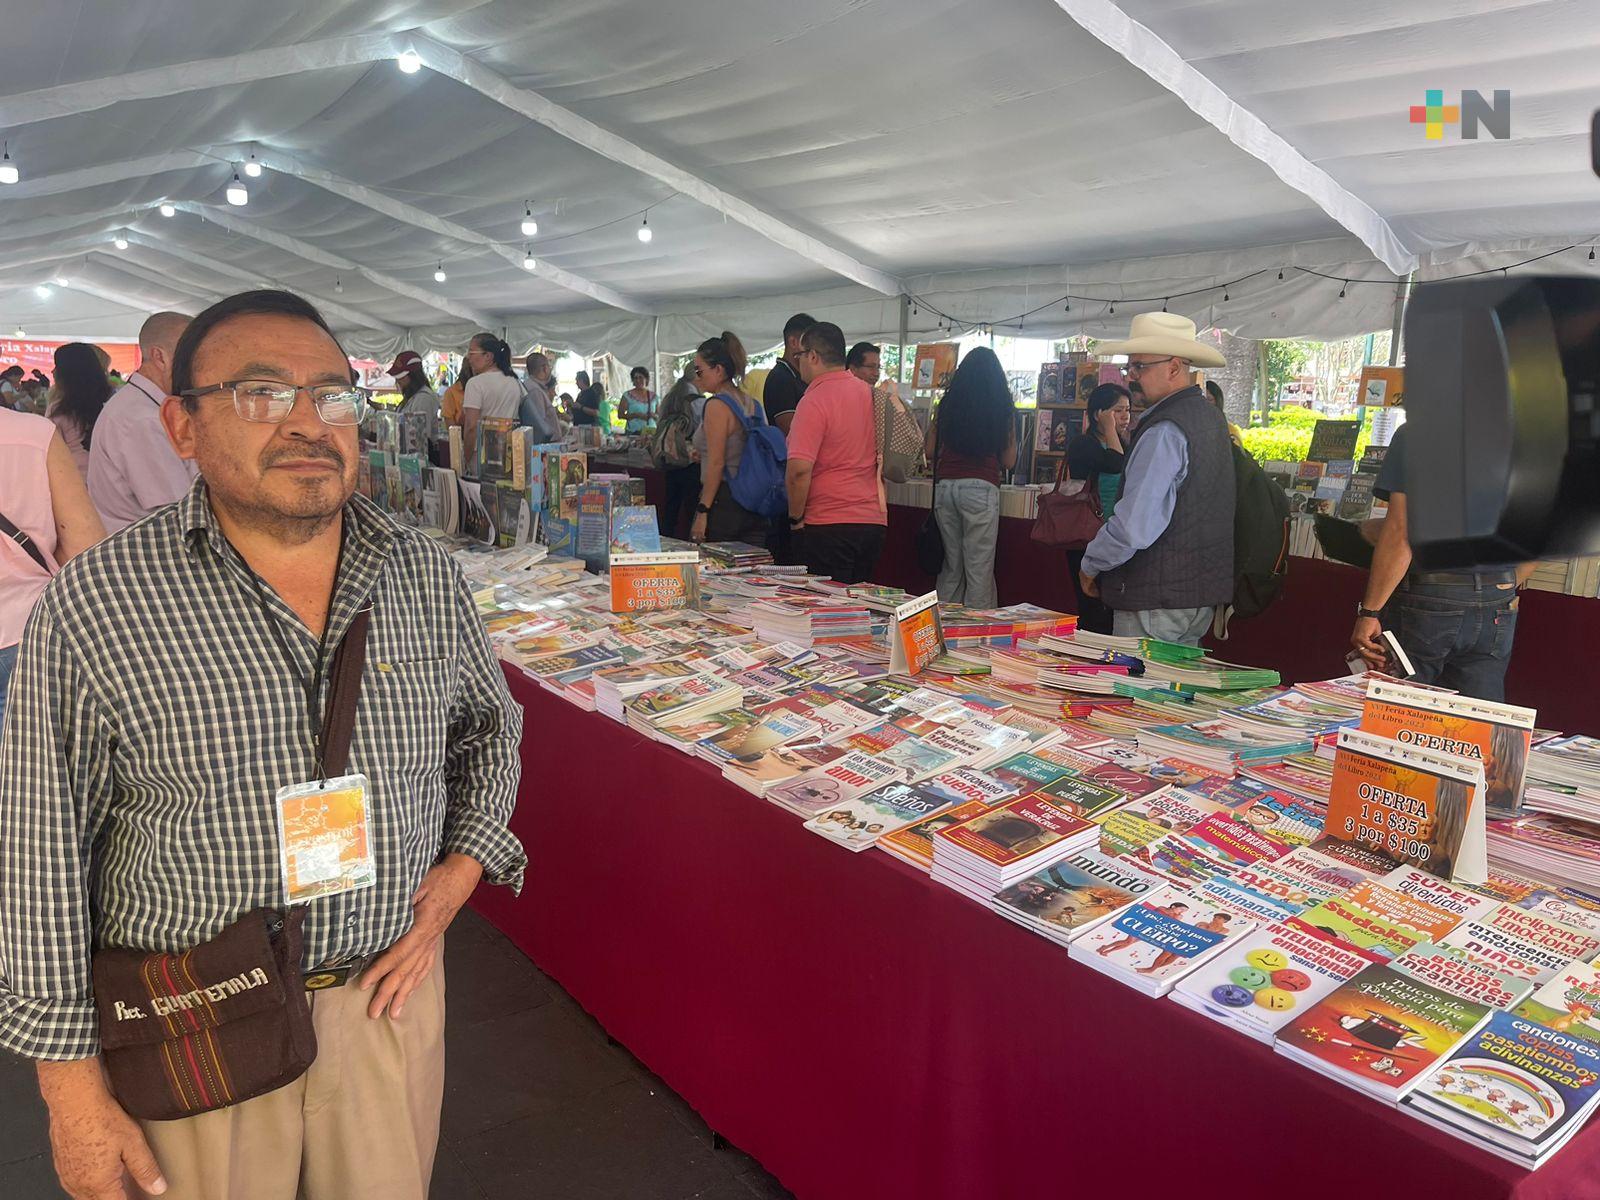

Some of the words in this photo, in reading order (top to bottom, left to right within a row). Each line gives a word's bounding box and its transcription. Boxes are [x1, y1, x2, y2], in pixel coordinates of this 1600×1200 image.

[632, 577, 680, 588] OFERTA
[637, 589, 643, 598] 1
[646, 589, 654, 598] a
[655, 588, 677, 598] $35
[627, 598, 635, 608] 3
[637, 599, 658, 610] por
[1382, 713, 1403, 724] Libro
[1385, 704, 1406, 716] Feria
[1405, 708, 1444, 723] Xalapeña
[935, 730, 982, 751] Palabras
[1397, 729, 1483, 760] OFERTA
[824, 765, 874, 788] amor
[848, 753, 866, 763] LOS
[863, 757, 899, 776] MEJORES
[1026, 759, 1059, 773] LEYENDAS
[1347, 764, 1365, 777] Libro
[1350, 754, 1366, 766] Feria
[1366, 758, 1397, 776] Xalapeña
[936, 774, 991, 801] sueños
[953, 768, 1005, 795] DICCIONARIO
[1067, 781, 1104, 796] LEYENDAS
[1055, 790, 1085, 803] PUEBLA
[1159, 795, 1200, 817] TENGO
[1359, 783, 1428, 819] OFERTA
[1020, 808, 1061, 831] VERACRUZ
[1036, 801, 1078, 824] LEYENDAS
[1040, 812, 1055, 820] DE
[1361, 804, 1369, 819] 1
[1373, 809, 1383, 824] a
[1388, 811, 1419, 836] $35
[1205, 825, 1270, 862] matemáticos
[1242, 832, 1282, 860] pasatiempos
[1345, 817, 1354, 832] 3
[1357, 824, 1385, 843] por
[1388, 831, 1431, 861] $100
[1097, 859, 1137, 878] LEYENDAS
[1327, 844, 1382, 867] CUENTOS
[1340, 843, 1358, 853] LOS
[1358, 849, 1397, 867] MEJORES
[1069, 854, 1150, 894] mundo
[1202, 882, 1289, 921] adivinanzas
[1235, 870, 1324, 908] niños
[1398, 879, 1469, 915] divertidos
[1407, 872, 1481, 907] SÚPER
[1202, 890, 1229, 906] rondas
[1232, 905, 1272, 923] canciones
[1122, 917, 1199, 952] CUERPO?
[1322, 900, 1418, 948] Sudoku
[1351, 928, 1381, 941] para
[1411, 916, 1433, 928] para
[1496, 905, 1600, 950] Inteligencia
[1189, 929, 1213, 943] pasa
[1265, 924, 1366, 971] INTELIGENCIA
[1492, 916, 1587, 957] Emocional
[1271, 937, 1358, 978] emocional
[1289, 954, 1317, 969] sana
[1316, 966, 1329, 975] tu
[1327, 972, 1348, 983] ser
[1470, 964, 1496, 977] más
[150, 967, 269, 1017] GUATEMALA
[1376, 981, 1425, 1005] Magia
[1424, 1002, 1465, 1021] para
[1392, 978, 1442, 1003] Trucos
[1443, 1001, 1465, 1011] de
[1360, 982, 1463, 1034] Principiantes
[1511, 1020, 1600, 1060] canciones,
[1479, 1040, 1582, 1089] adivinanzas
[1480, 1031, 1599, 1081] pasatiempos
